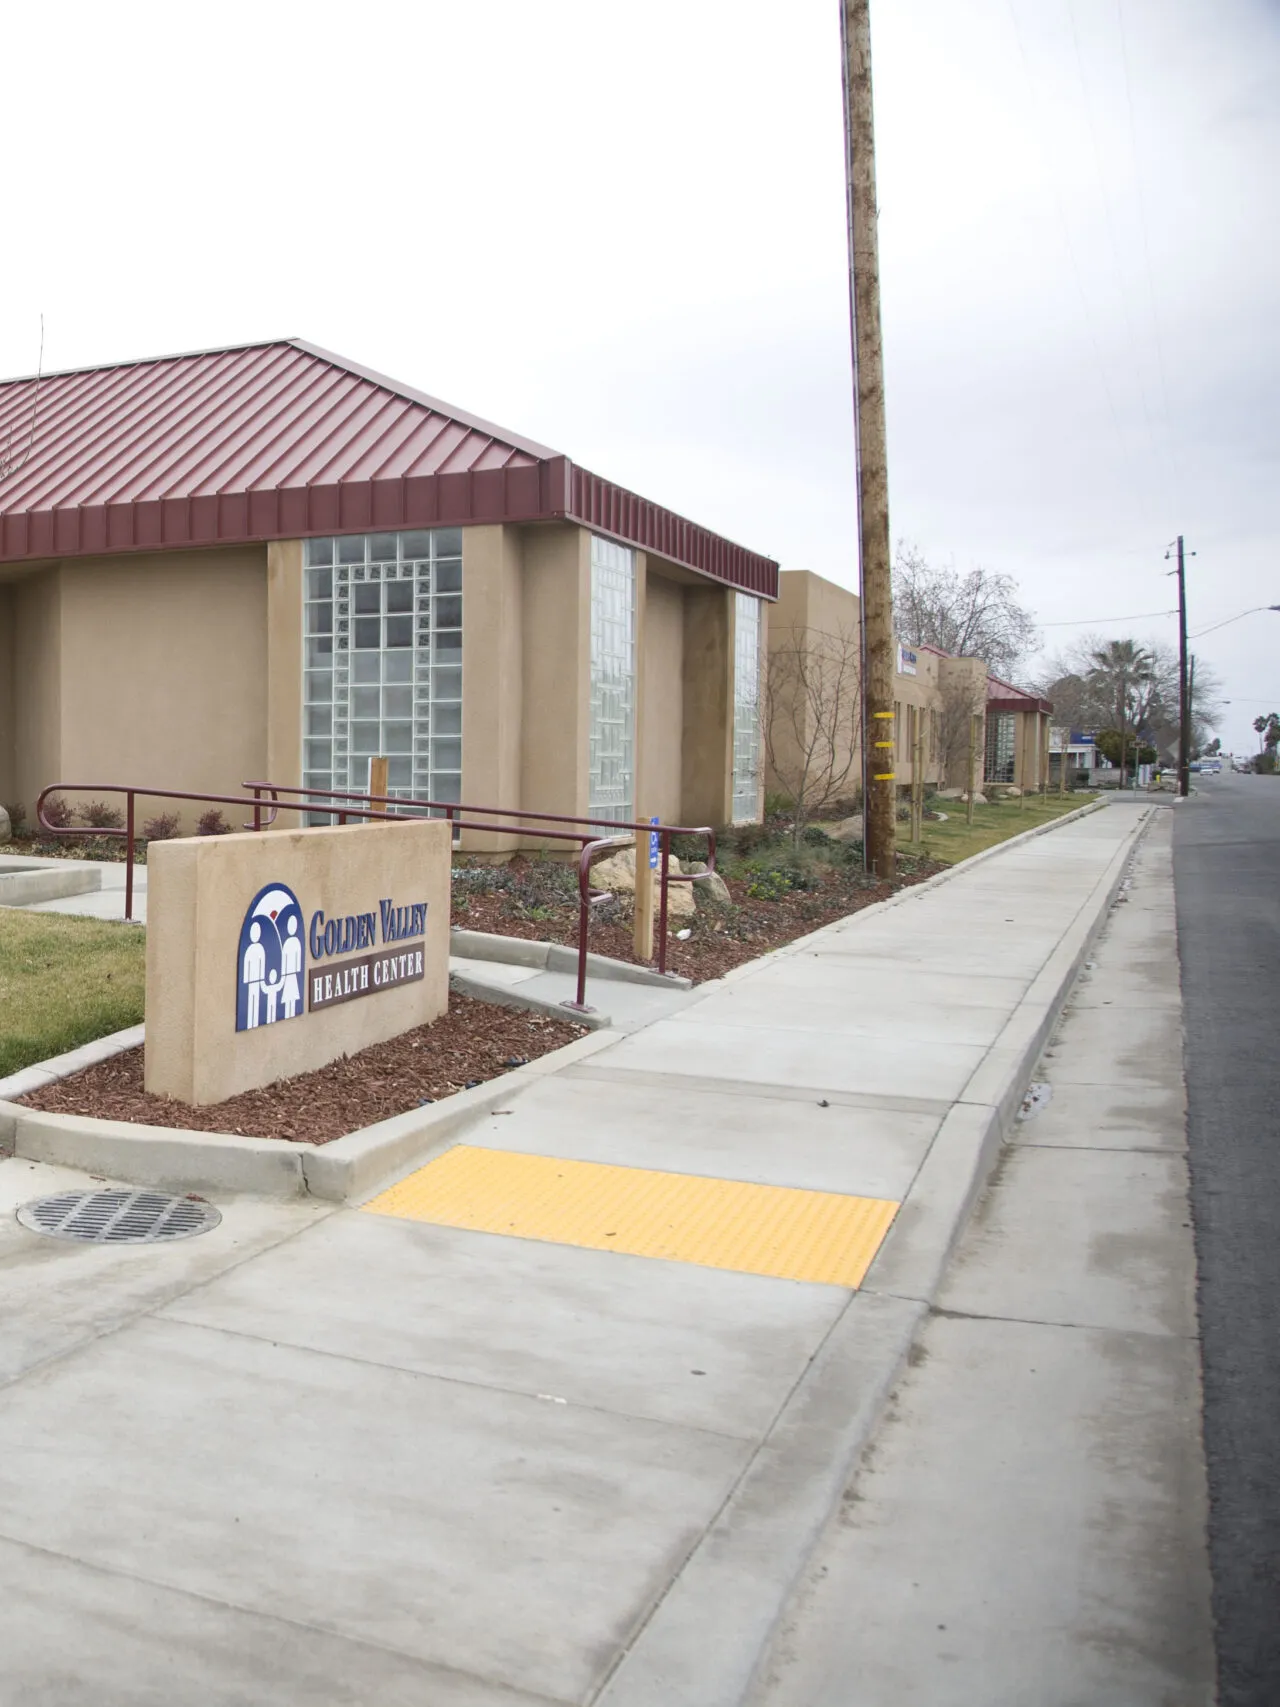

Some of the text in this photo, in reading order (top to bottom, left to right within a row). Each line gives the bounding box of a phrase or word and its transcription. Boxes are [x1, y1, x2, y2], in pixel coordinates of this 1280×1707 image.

[310, 899, 428, 960] GOLDEN VALLEY
[313, 951, 423, 1003] HEALTH CENTER
